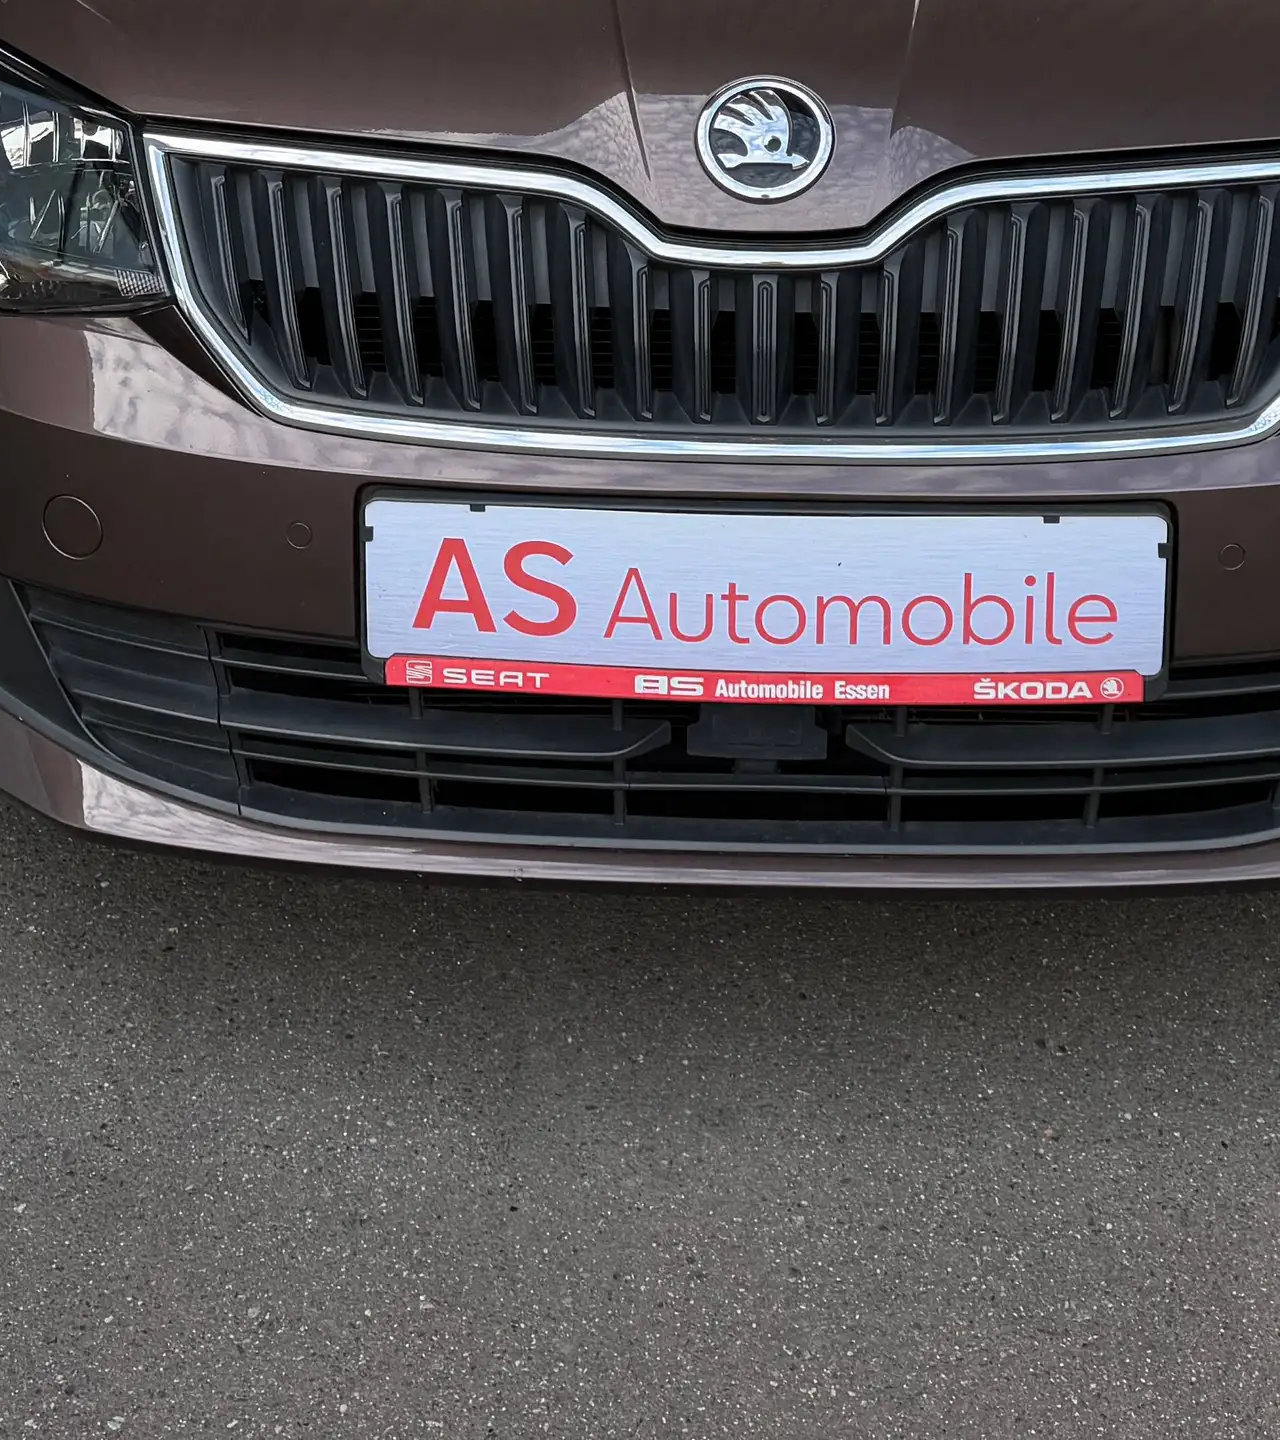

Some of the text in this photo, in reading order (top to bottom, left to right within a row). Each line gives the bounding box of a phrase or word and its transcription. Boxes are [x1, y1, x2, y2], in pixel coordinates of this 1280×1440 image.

[412, 537, 1118, 647] AS Automobile
[442, 667, 550, 689] SEAT
[714, 678, 824, 700] Automobile
[834, 679, 890, 700] Essen
[973, 677, 1093, 700] ŠKODA
